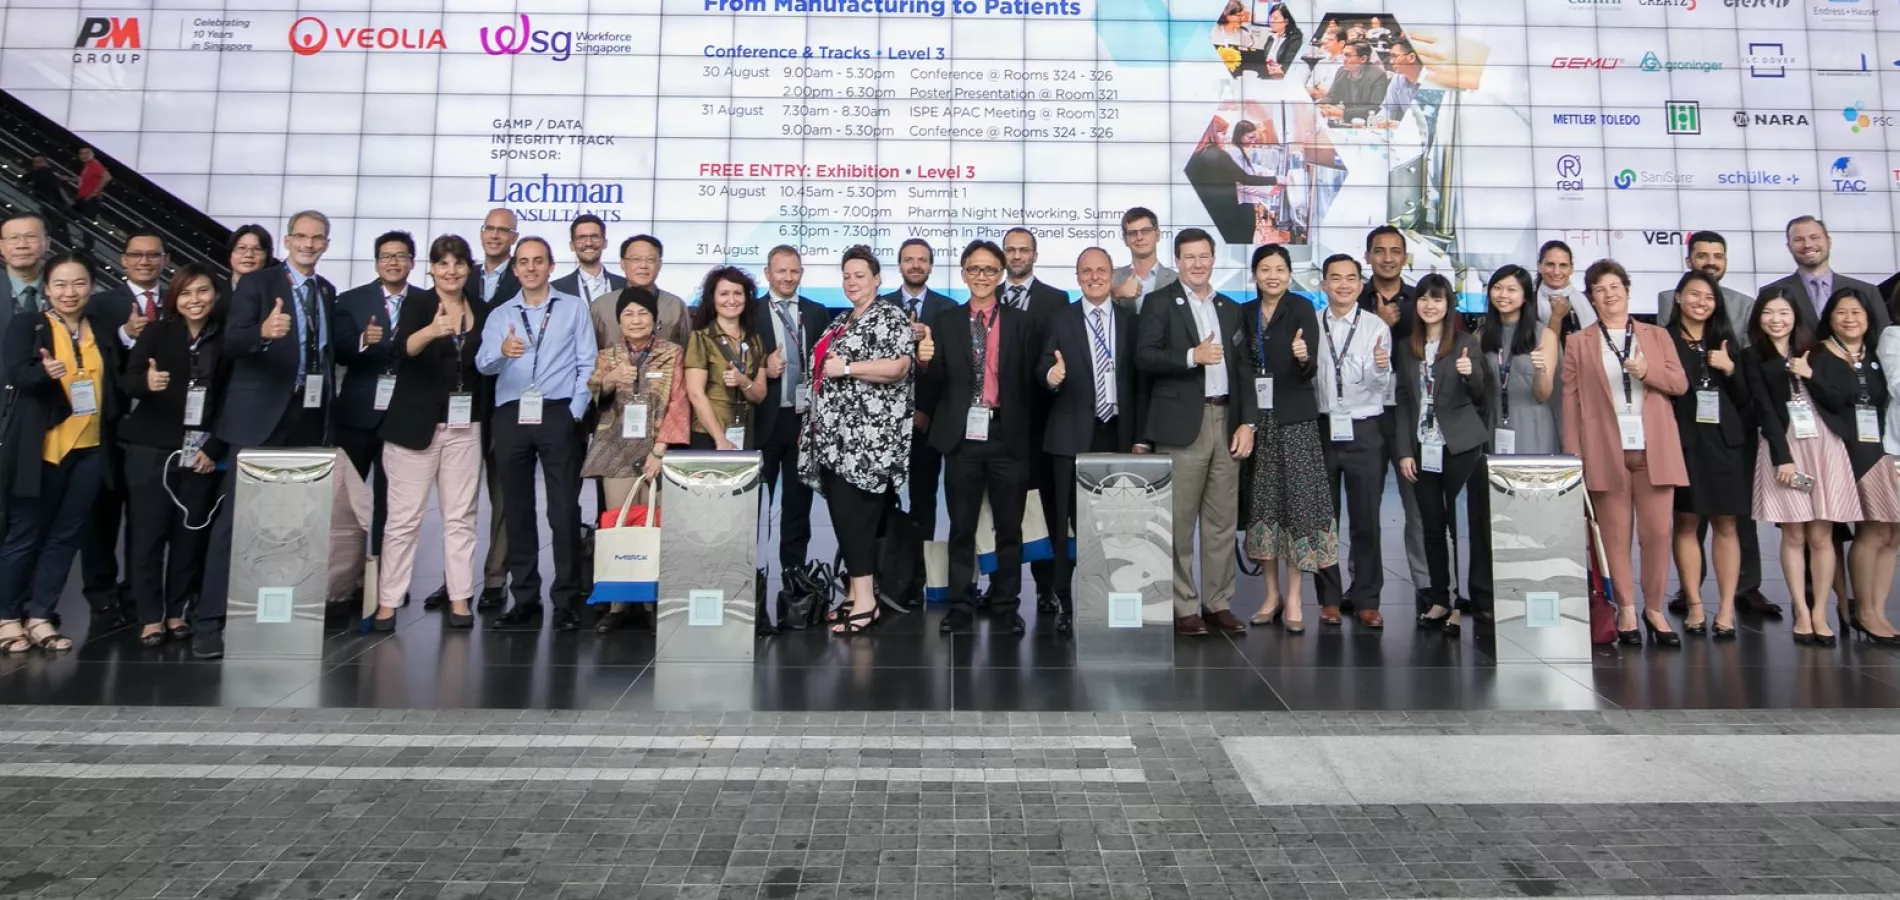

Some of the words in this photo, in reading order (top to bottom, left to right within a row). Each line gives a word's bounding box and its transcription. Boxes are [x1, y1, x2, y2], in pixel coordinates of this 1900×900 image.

[704, 0, 766, 12] From
[774, 0, 945, 17] Manufacturing
[954, 0, 977, 14] to
[984, 0, 1081, 15] Patients
[193, 18, 251, 28] Celebrating
[74, 17, 141, 48] PM
[193, 30, 204, 38] 10
[207, 30, 234, 38] Years
[335, 27, 448, 49] VEOLIA
[575, 31, 632, 42] Workforce
[191, 42, 200, 50] in
[203, 42, 253, 52] Singapore
[575, 42, 632, 55] Singapore
[704, 44, 798, 58] Conference
[802, 46, 814, 59] &
[818, 46, 871, 59] Tracks
[888, 47, 930, 60] Level
[936, 48, 945, 60] 3
[72, 53, 140, 64] GROUP
[1664, 61, 1723, 73] groninger
[702, 66, 720, 77] 30
[724, 66, 770, 80] August
[783, 67, 833, 78] 9.00am
[845, 68, 895, 81] 5.30pm
[910, 68, 984, 80] Conference
[987, 70, 1000, 82] @
[1004, 70, 1049, 80] Rooms
[1053, 70, 1076, 80] 324
[1090, 70, 1113, 81] 326
[783, 86, 834, 98] 2.00pm
[846, 87, 896, 100] 6.30pm
[910, 88, 952, 98] Poster
[955, 88, 1035, 100] Presentation
[1039, 89, 1052, 100] @
[1056, 89, 1094, 100] Room
[1098, 89, 1118, 100] 321
[702, 104, 714, 116] 31
[718, 104, 764, 118] August
[783, 105, 830, 116] 7.30am
[842, 106, 890, 117] 8.30am
[910, 106, 938, 117] ISPE
[942, 106, 981, 118] APAC
[984, 107, 1036, 120] Meeting
[1040, 108, 1052, 120] @
[1056, 108, 1094, 119] Room
[1099, 108, 1119, 119] 321
[492, 119, 532, 129] GAMP
[548, 120, 583, 130] DATA
[1553, 114, 1596, 125] METTLER
[1600, 114, 1640, 125] TOLEDO
[1755, 114, 1809, 126] NARA
[782, 124, 832, 136] 9.00am
[845, 126, 894, 138] 5.30pm
[910, 125, 984, 137] Conference
[987, 126, 1000, 138] @
[1004, 127, 1049, 138] Rooms
[1053, 127, 1076, 138] 324
[1090, 128, 1114, 138] 326
[492, 134, 563, 144] INTEGRITY
[569, 136, 615, 145] TRACK
[490, 149, 561, 160] SPONSOR:
[700, 164, 744, 176] FREE
[750, 164, 810, 177] ENTRY:
[816, 165, 899, 178] Exhibition
[918, 166, 960, 178] Level
[966, 166, 976, 178] 3
[1718, 171, 1781, 184] schülke
[488, 172, 624, 203] Lachman
[1556, 178, 1584, 190] real
[1832, 180, 1867, 192] TAC
[698, 186, 716, 196] 30
[720, 186, 766, 199] August
[780, 186, 834, 198] 10.45am
[846, 187, 896, 200] 5.30pm
[908, 187, 960, 198] Summit
[780, 206, 830, 218] 5.30pm
[843, 206, 892, 219] 7.00pm
[908, 207, 958, 218] Pharma
[962, 208, 997, 220] Night
[1002, 208, 1080, 220] Networking,
[779, 225, 830, 238] 6.30pm
[843, 226, 891, 238] 7.30pm
[908, 227, 958, 238] Women
[962, 228, 974, 238] In
[1031, 228, 1064, 238] Panel
[1068, 228, 1116, 239] Session
[696, 244, 708, 255] 31
[713, 244, 760, 257] August
